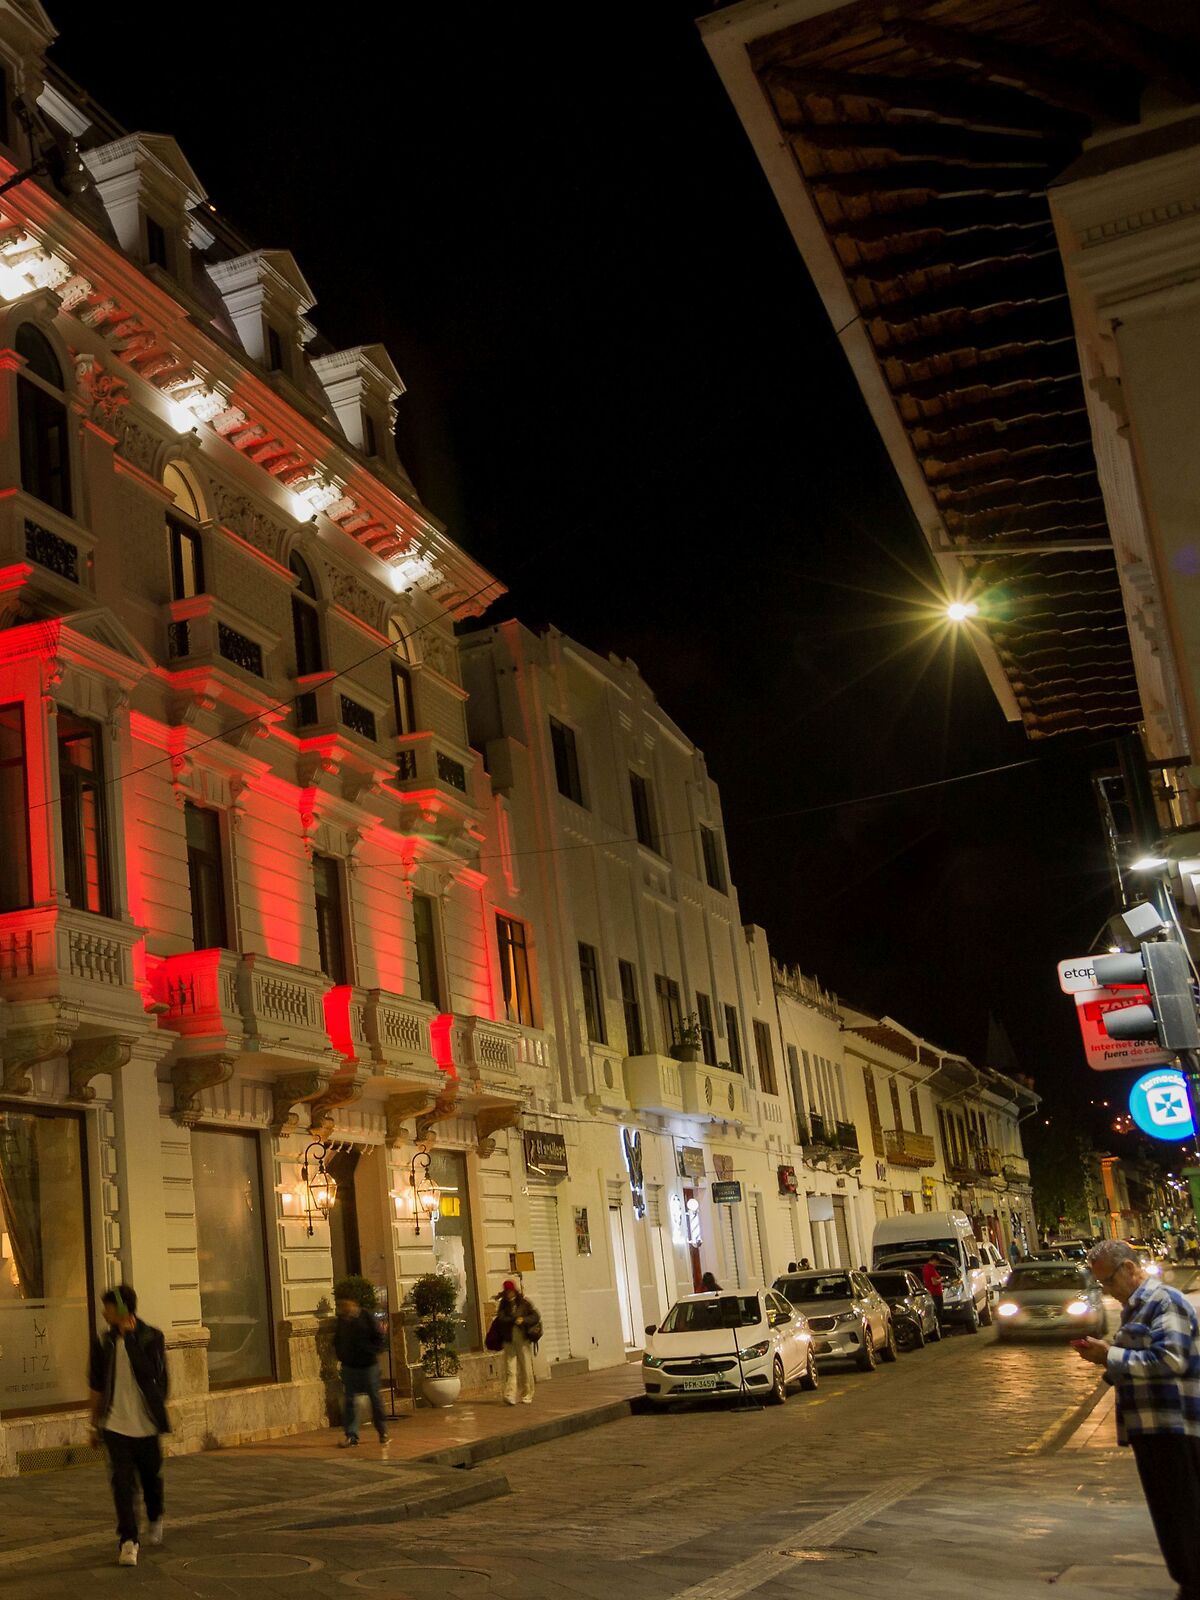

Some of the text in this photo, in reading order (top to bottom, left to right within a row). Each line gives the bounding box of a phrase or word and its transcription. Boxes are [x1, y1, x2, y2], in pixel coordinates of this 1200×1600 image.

[1064, 967, 1097, 979] etap
[1091, 1042, 1134, 1052] Internet
[1103, 1050, 1129, 1060] fuera
